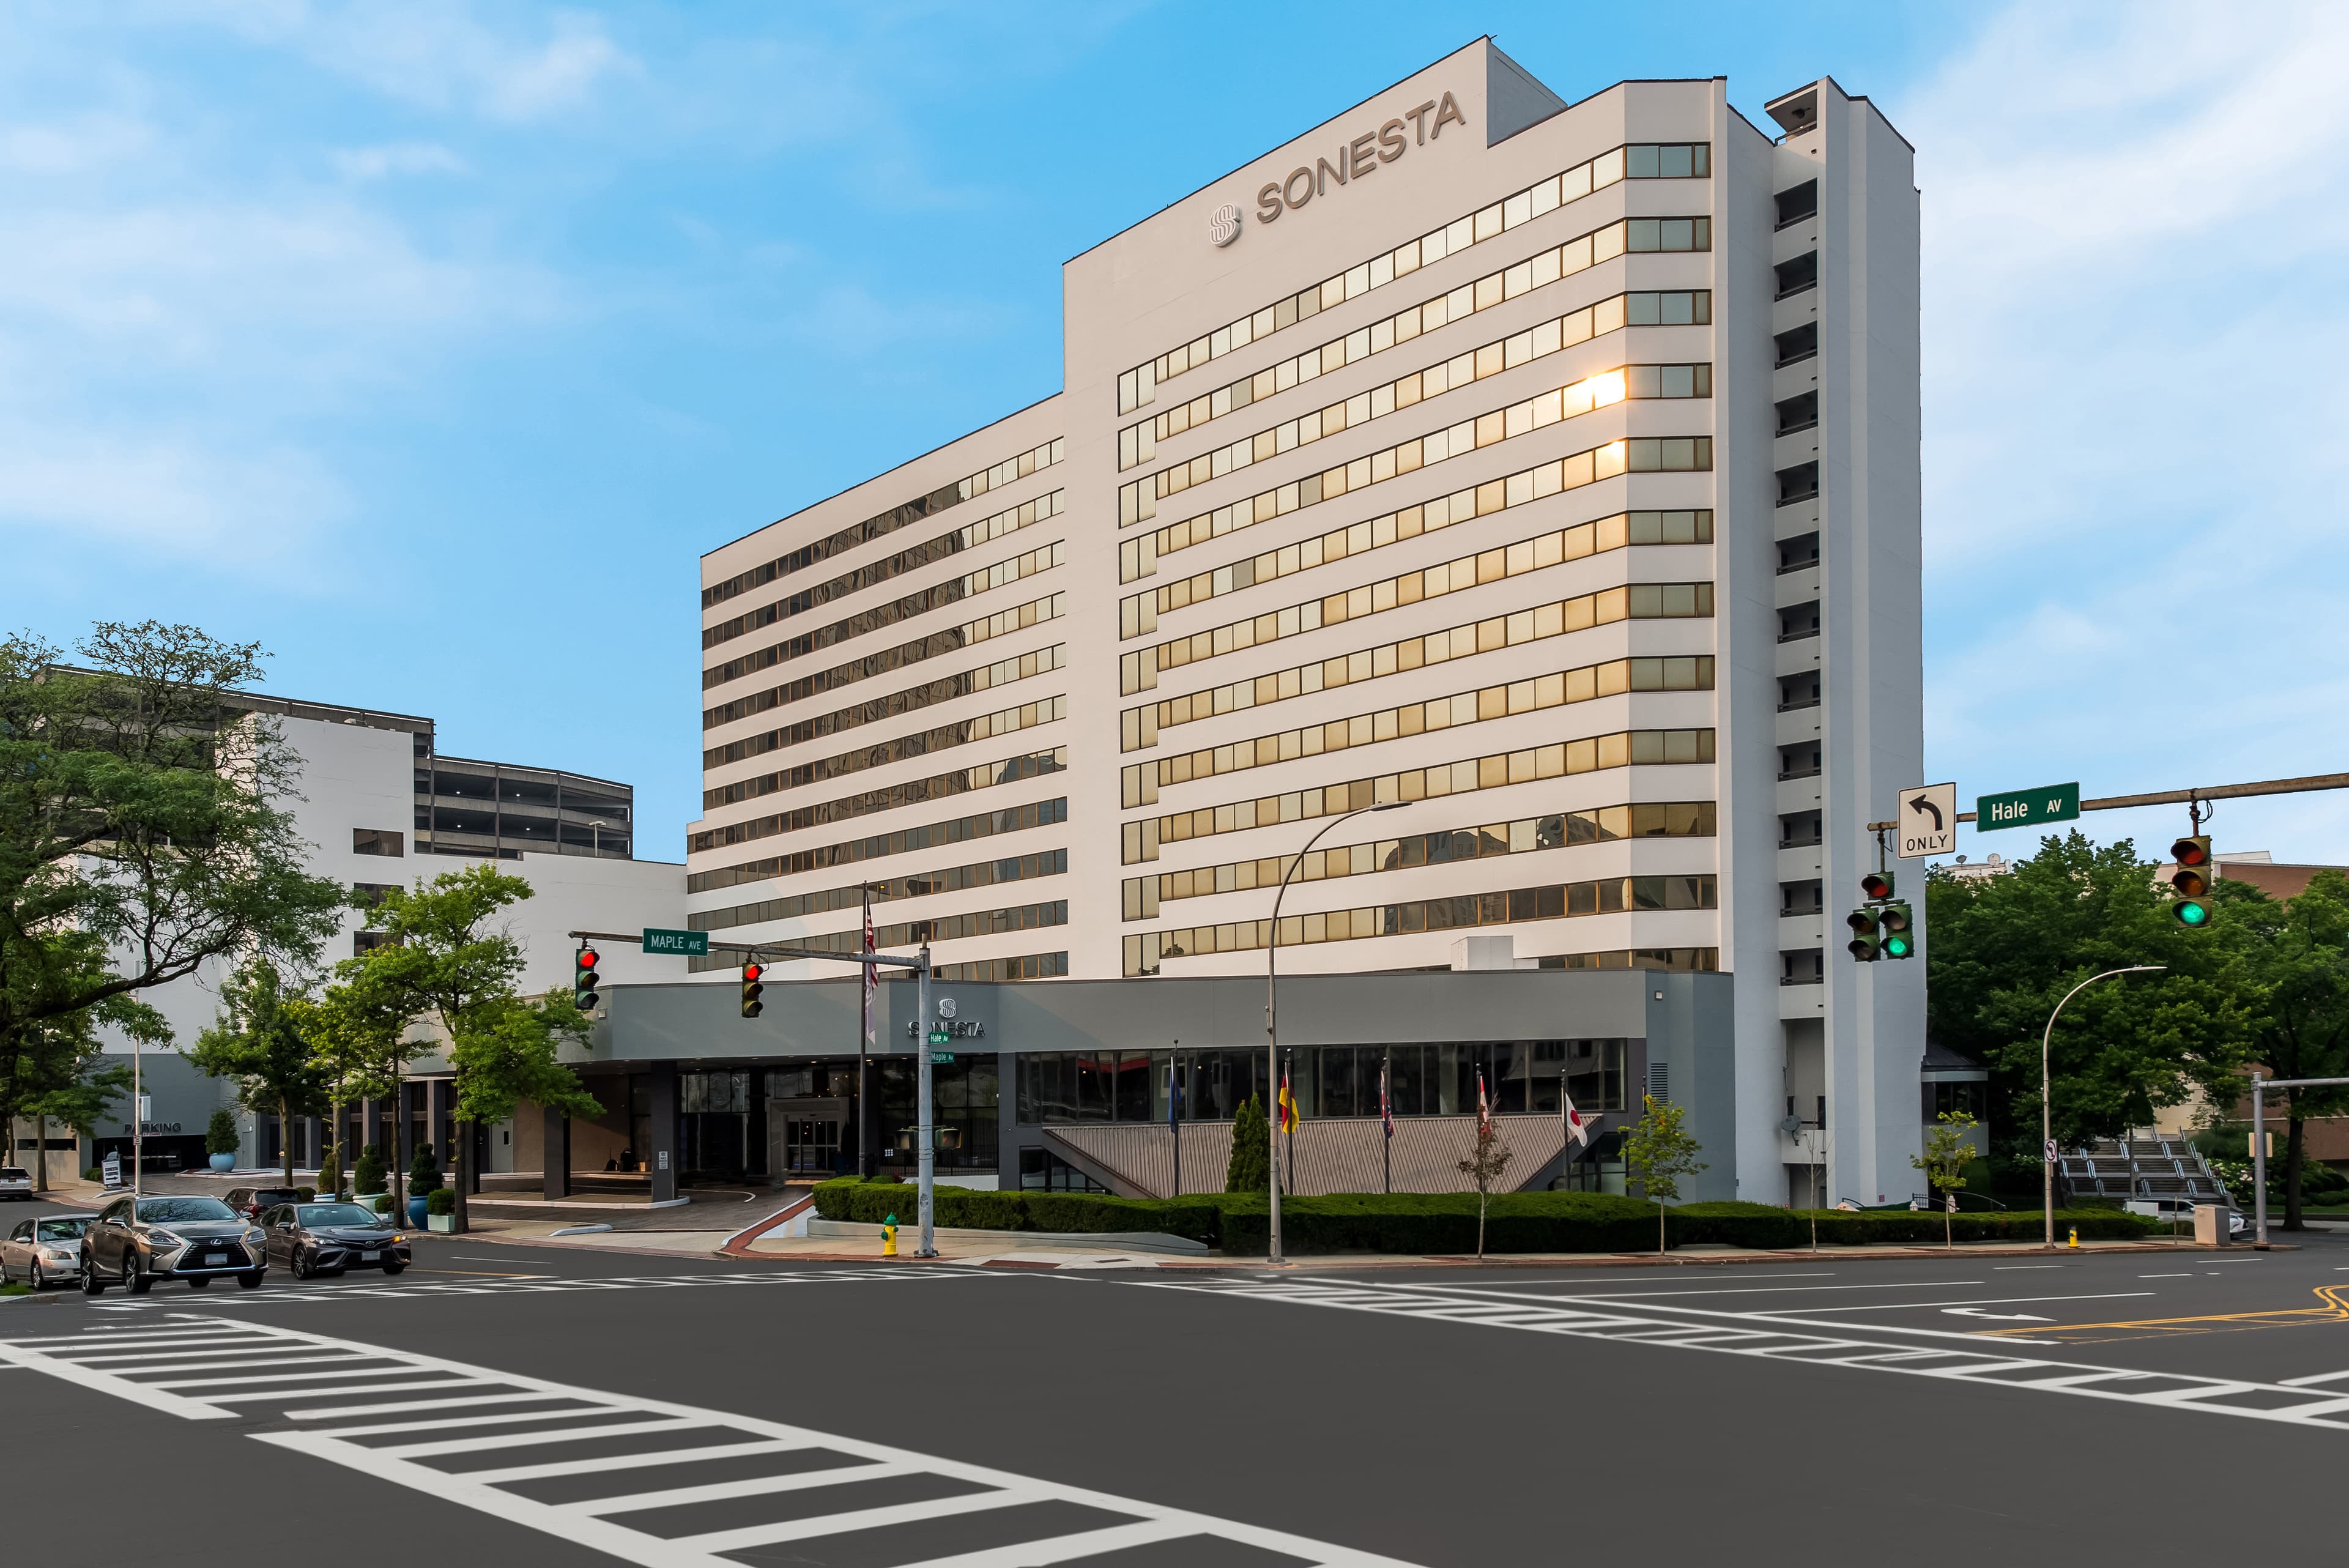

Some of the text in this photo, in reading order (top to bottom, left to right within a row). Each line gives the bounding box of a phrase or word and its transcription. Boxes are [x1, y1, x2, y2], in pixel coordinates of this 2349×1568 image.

[1256, 90, 1466, 223] SONESTA
[1992, 798, 2061, 822] Hale AV
[1906, 834, 1948, 852] ONLY
[651, 934, 702, 950] MAPLE AVE
[908, 1021, 985, 1037] SNESTA
[930, 1034, 941, 1042] Hale
[931, 1052, 946, 1062] Maple
